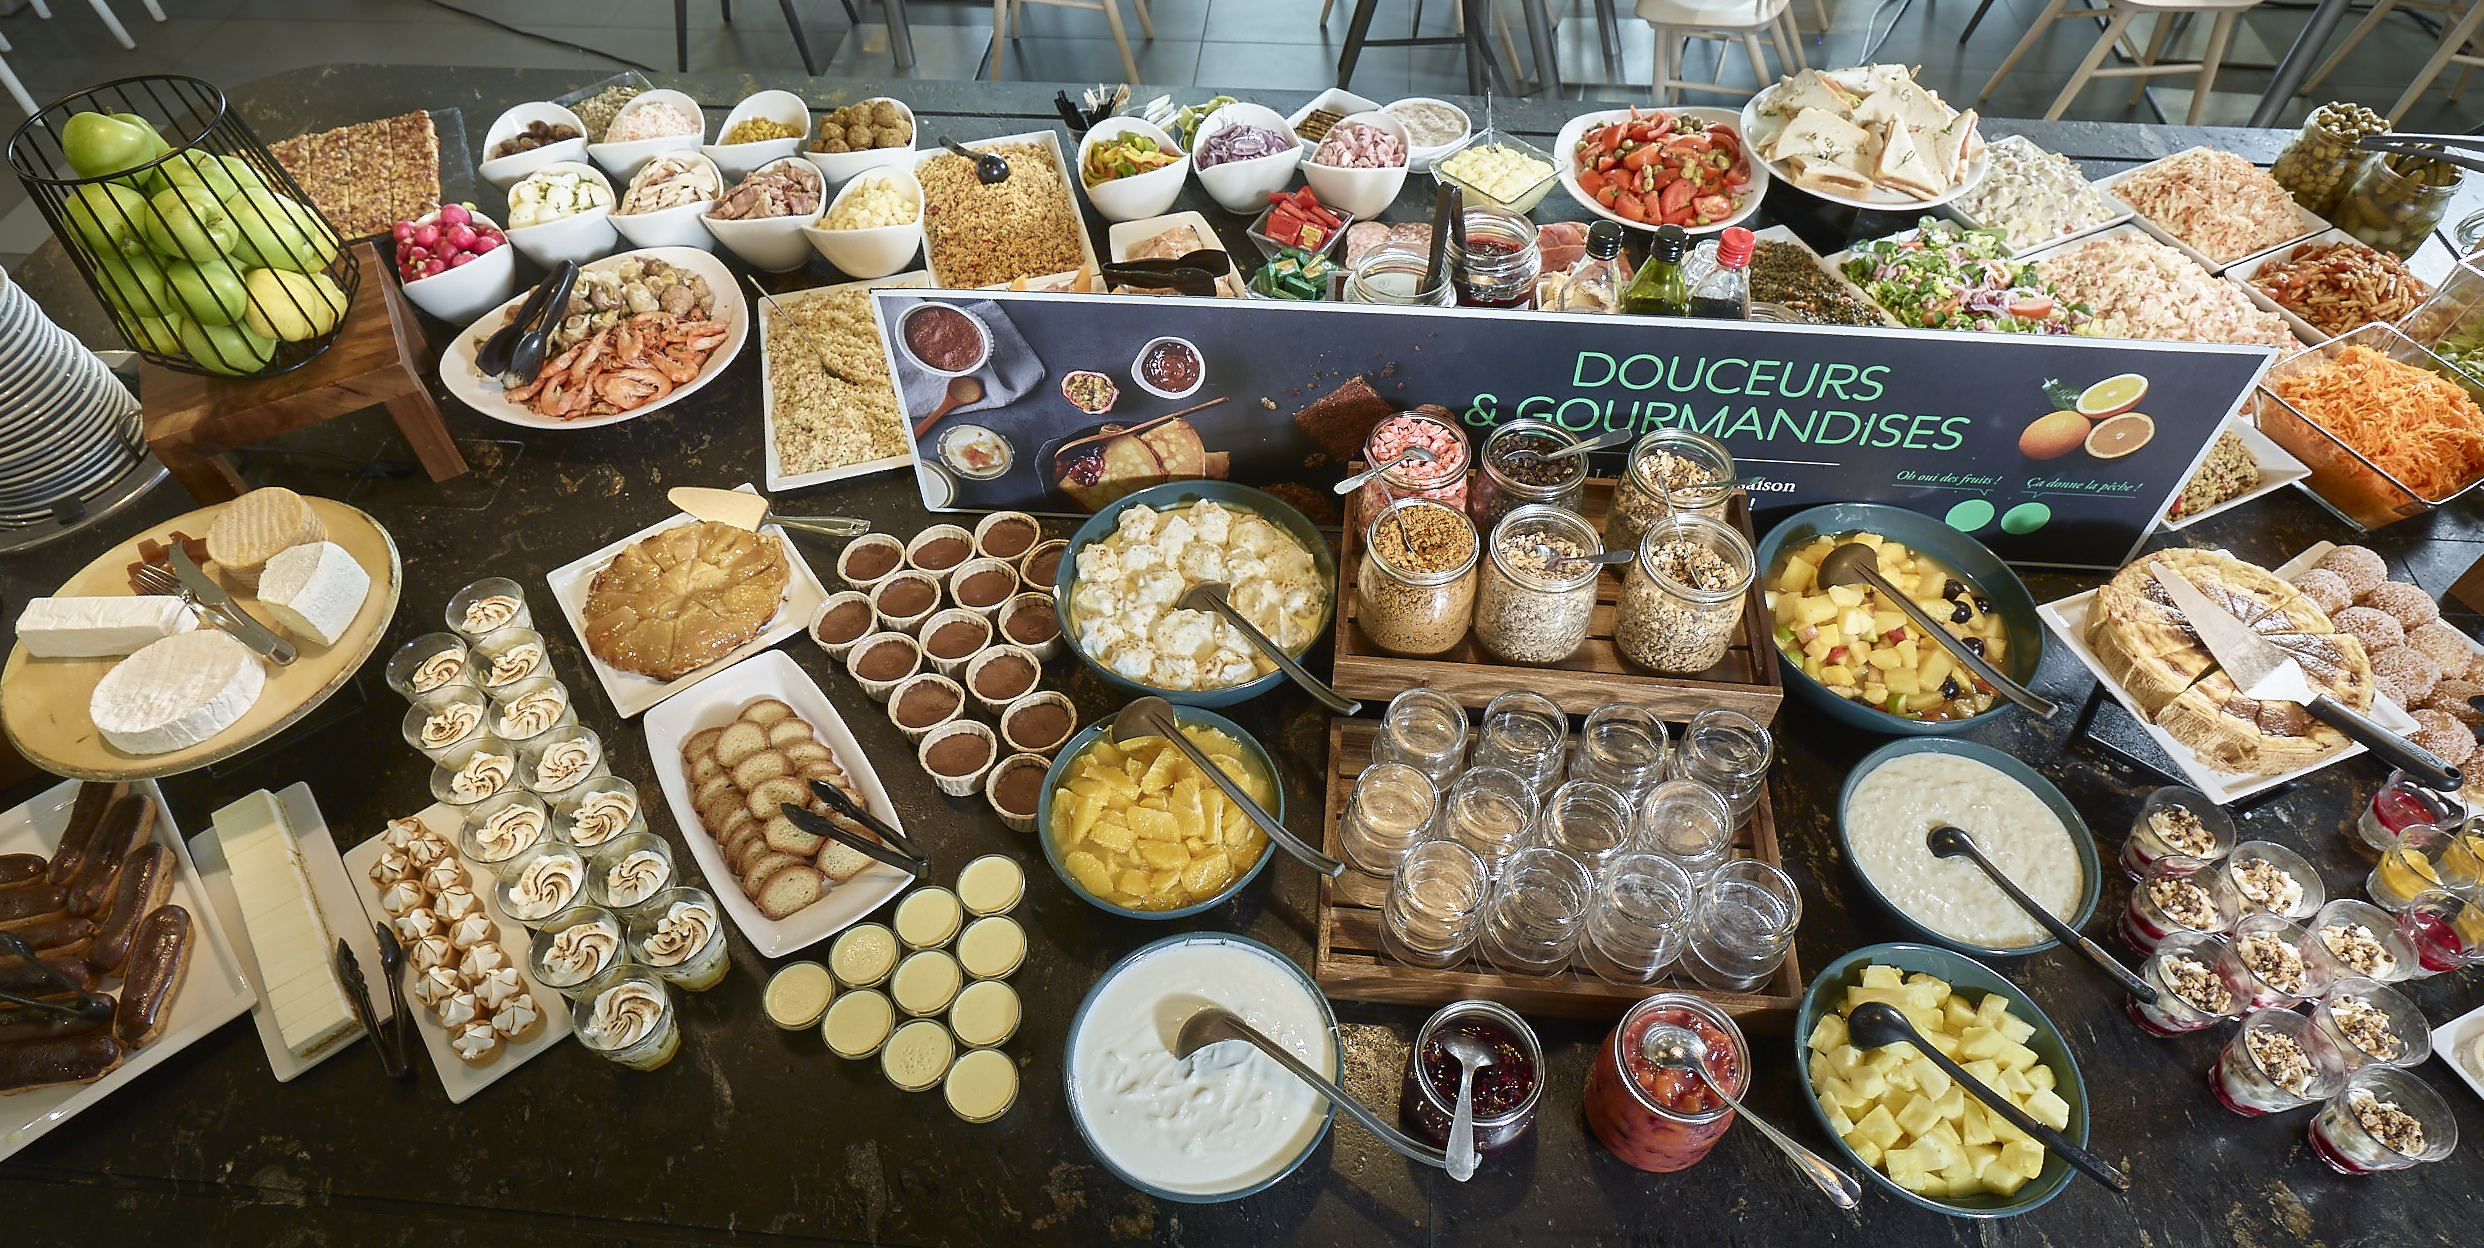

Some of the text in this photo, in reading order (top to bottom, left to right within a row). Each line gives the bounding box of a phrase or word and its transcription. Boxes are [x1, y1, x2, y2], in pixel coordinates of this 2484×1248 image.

[1572, 351, 1891, 403] DOUCEURS
[1463, 393, 1972, 451] & GOURMANDISES
[1896, 470, 1917, 481] Oh
[1917, 473, 1940, 482] oui
[1939, 472, 1959, 483] des
[2027, 477, 2046, 489] Ça
[2046, 478, 2085, 489] donne
[2084, 479, 2099, 490] la
